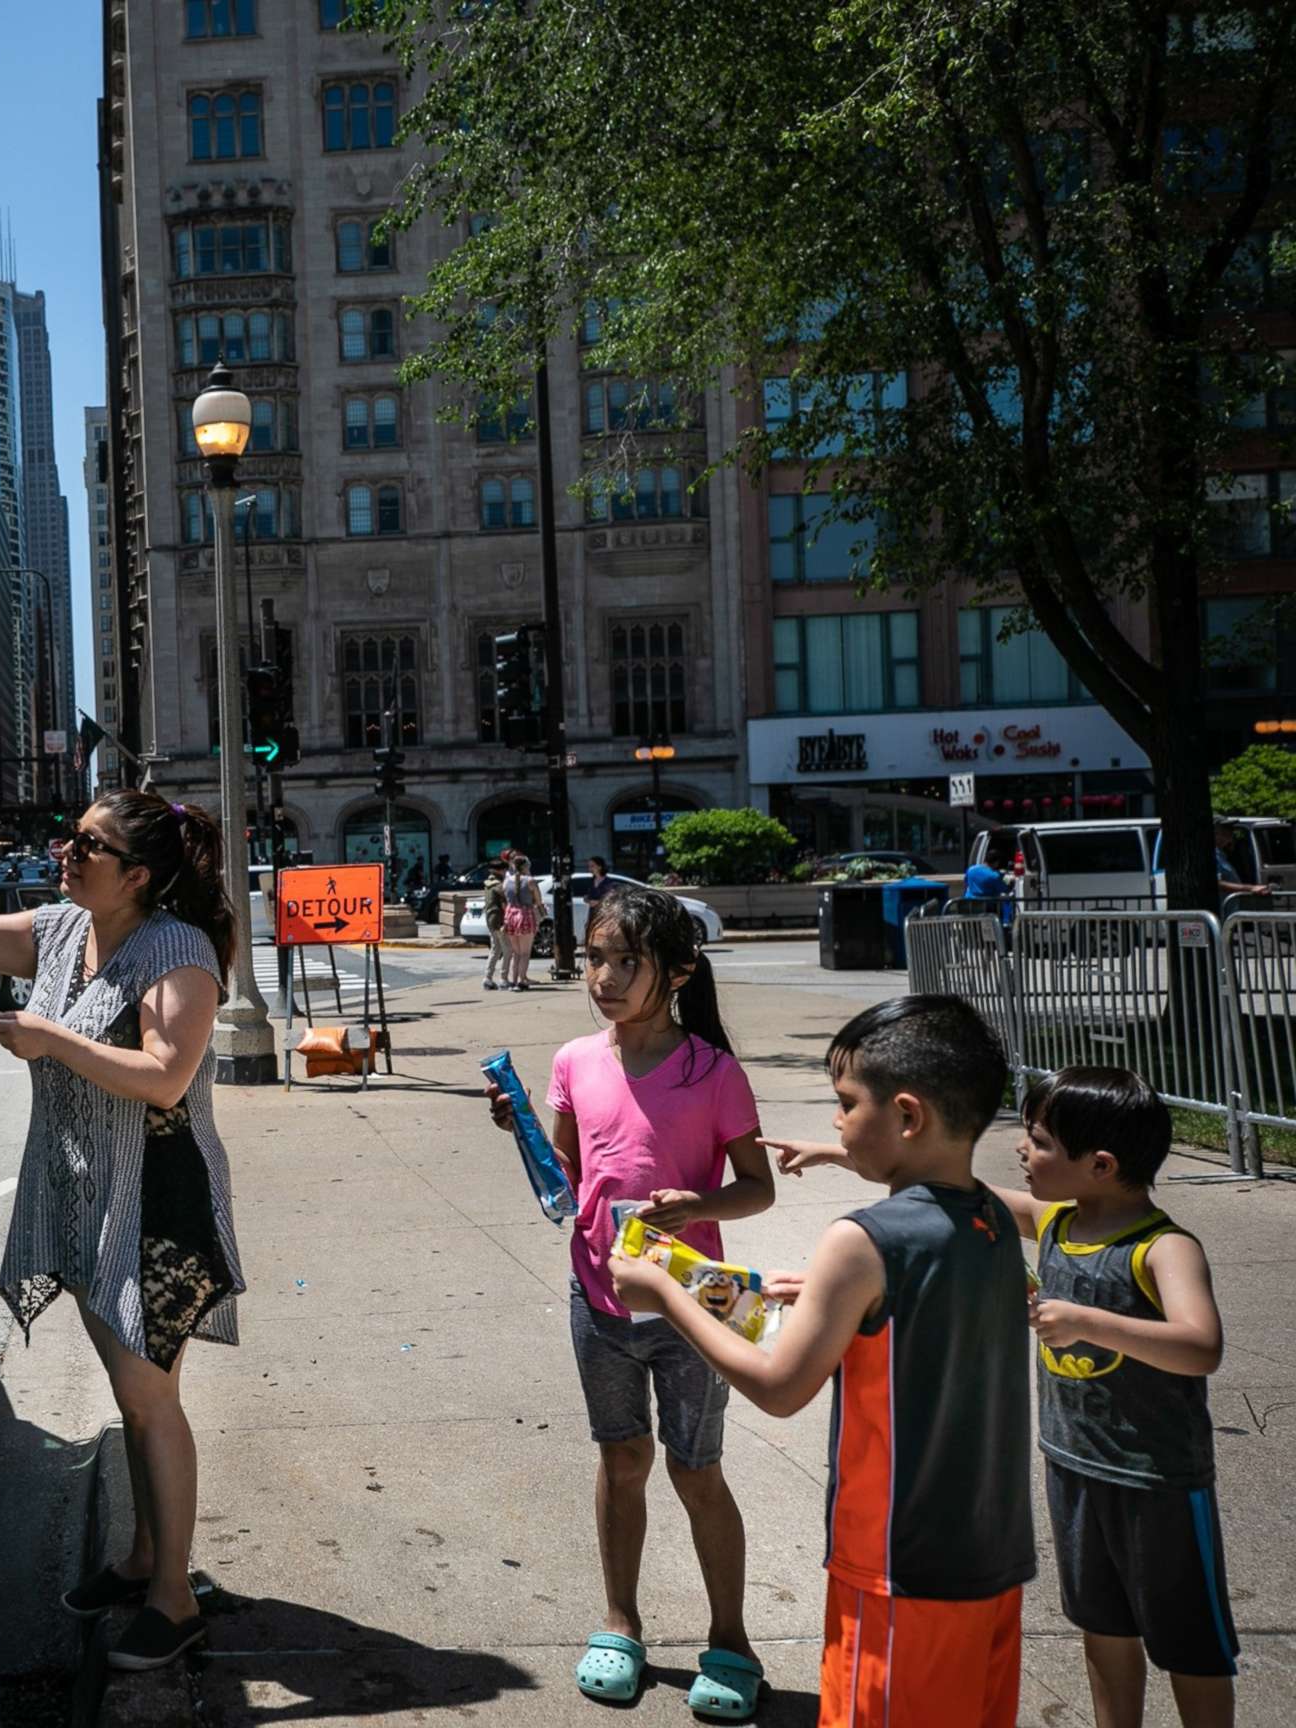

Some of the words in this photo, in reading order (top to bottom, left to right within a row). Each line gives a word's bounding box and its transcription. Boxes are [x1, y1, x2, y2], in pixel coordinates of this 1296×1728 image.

[932, 727, 959, 745] Hot
[1003, 724, 1041, 742] Cool
[941, 744, 979, 761] Woks
[1015, 741, 1061, 760] Sushi
[287, 896, 373, 918] DETOUR
